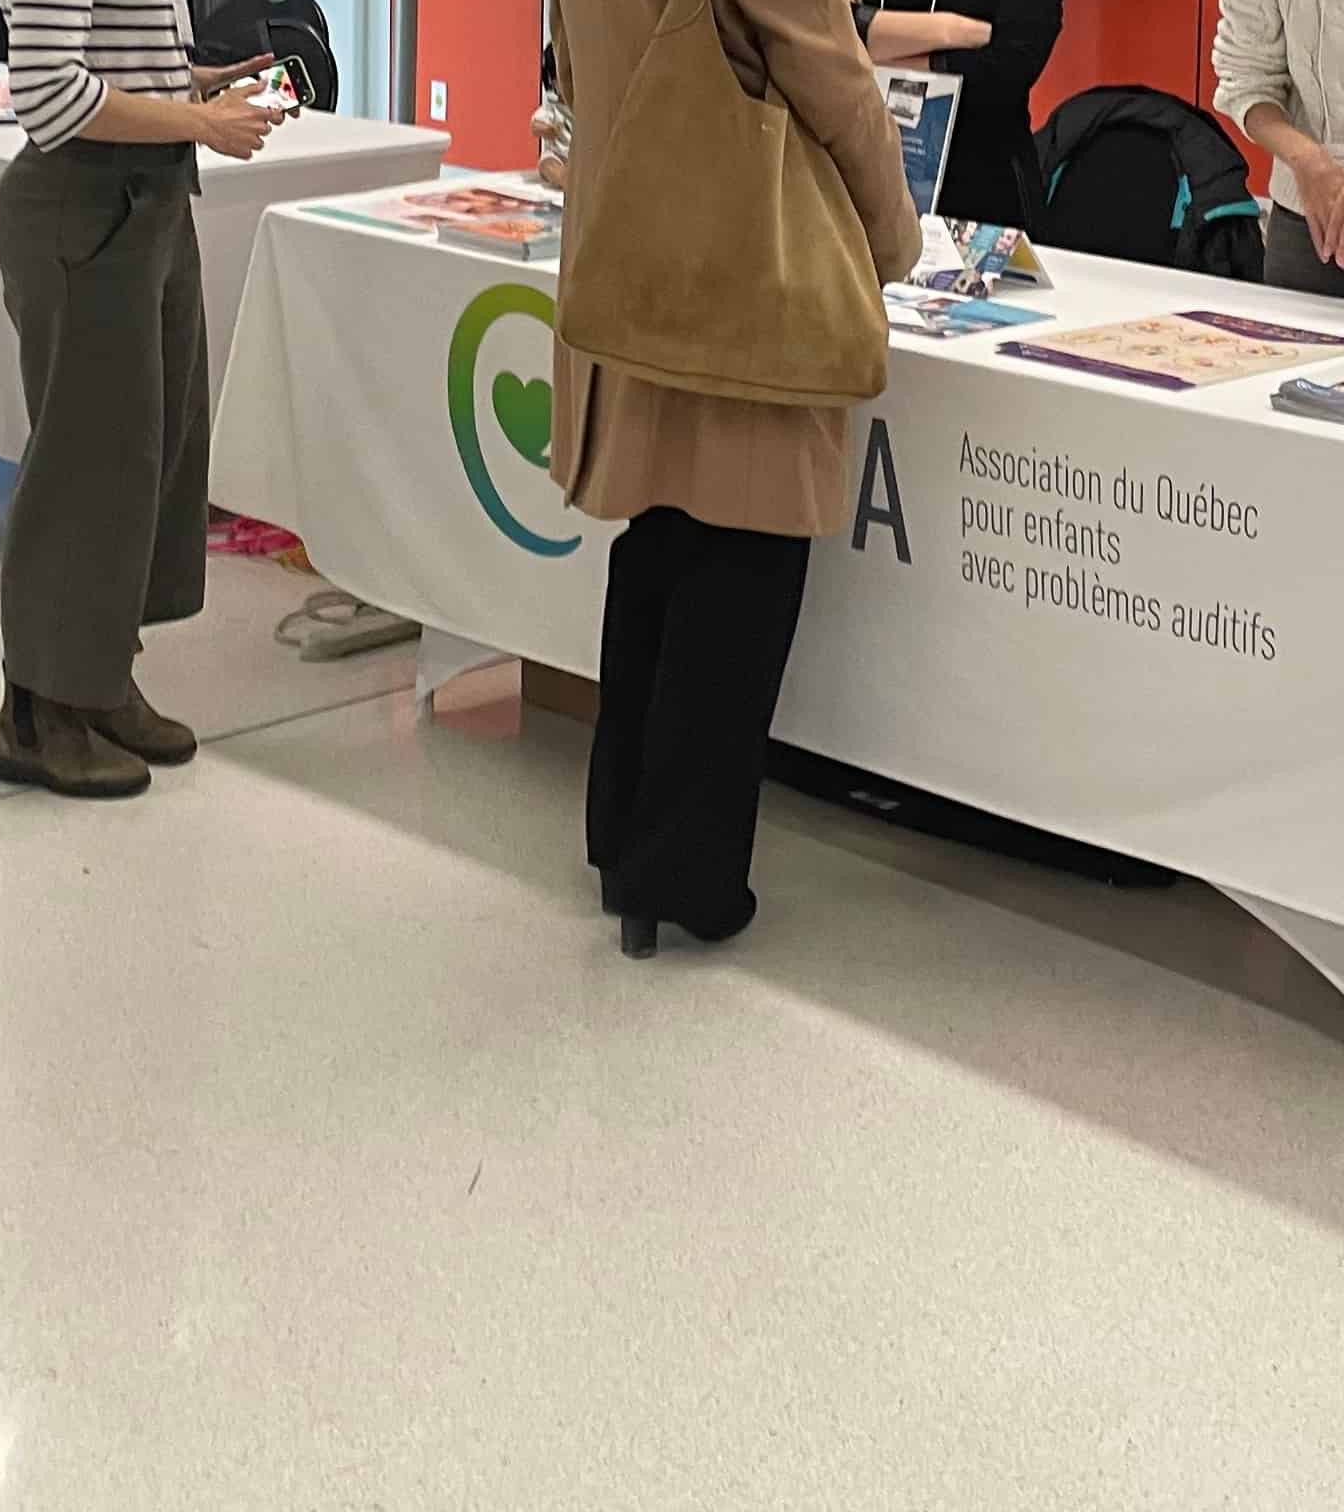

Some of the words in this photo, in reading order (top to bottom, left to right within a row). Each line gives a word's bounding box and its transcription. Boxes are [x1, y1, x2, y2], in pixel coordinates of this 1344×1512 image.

[959, 430, 1103, 505] Association
[1113, 466, 1145, 515] du
[1156, 473, 1259, 540] Québec
[961, 496, 1015, 539] pour
[1024, 508, 1122, 566] enfants
[961, 550, 1015, 593] avec
[1025, 565, 1162, 632] problèmes
[1171, 599, 1277, 661] auditifs
